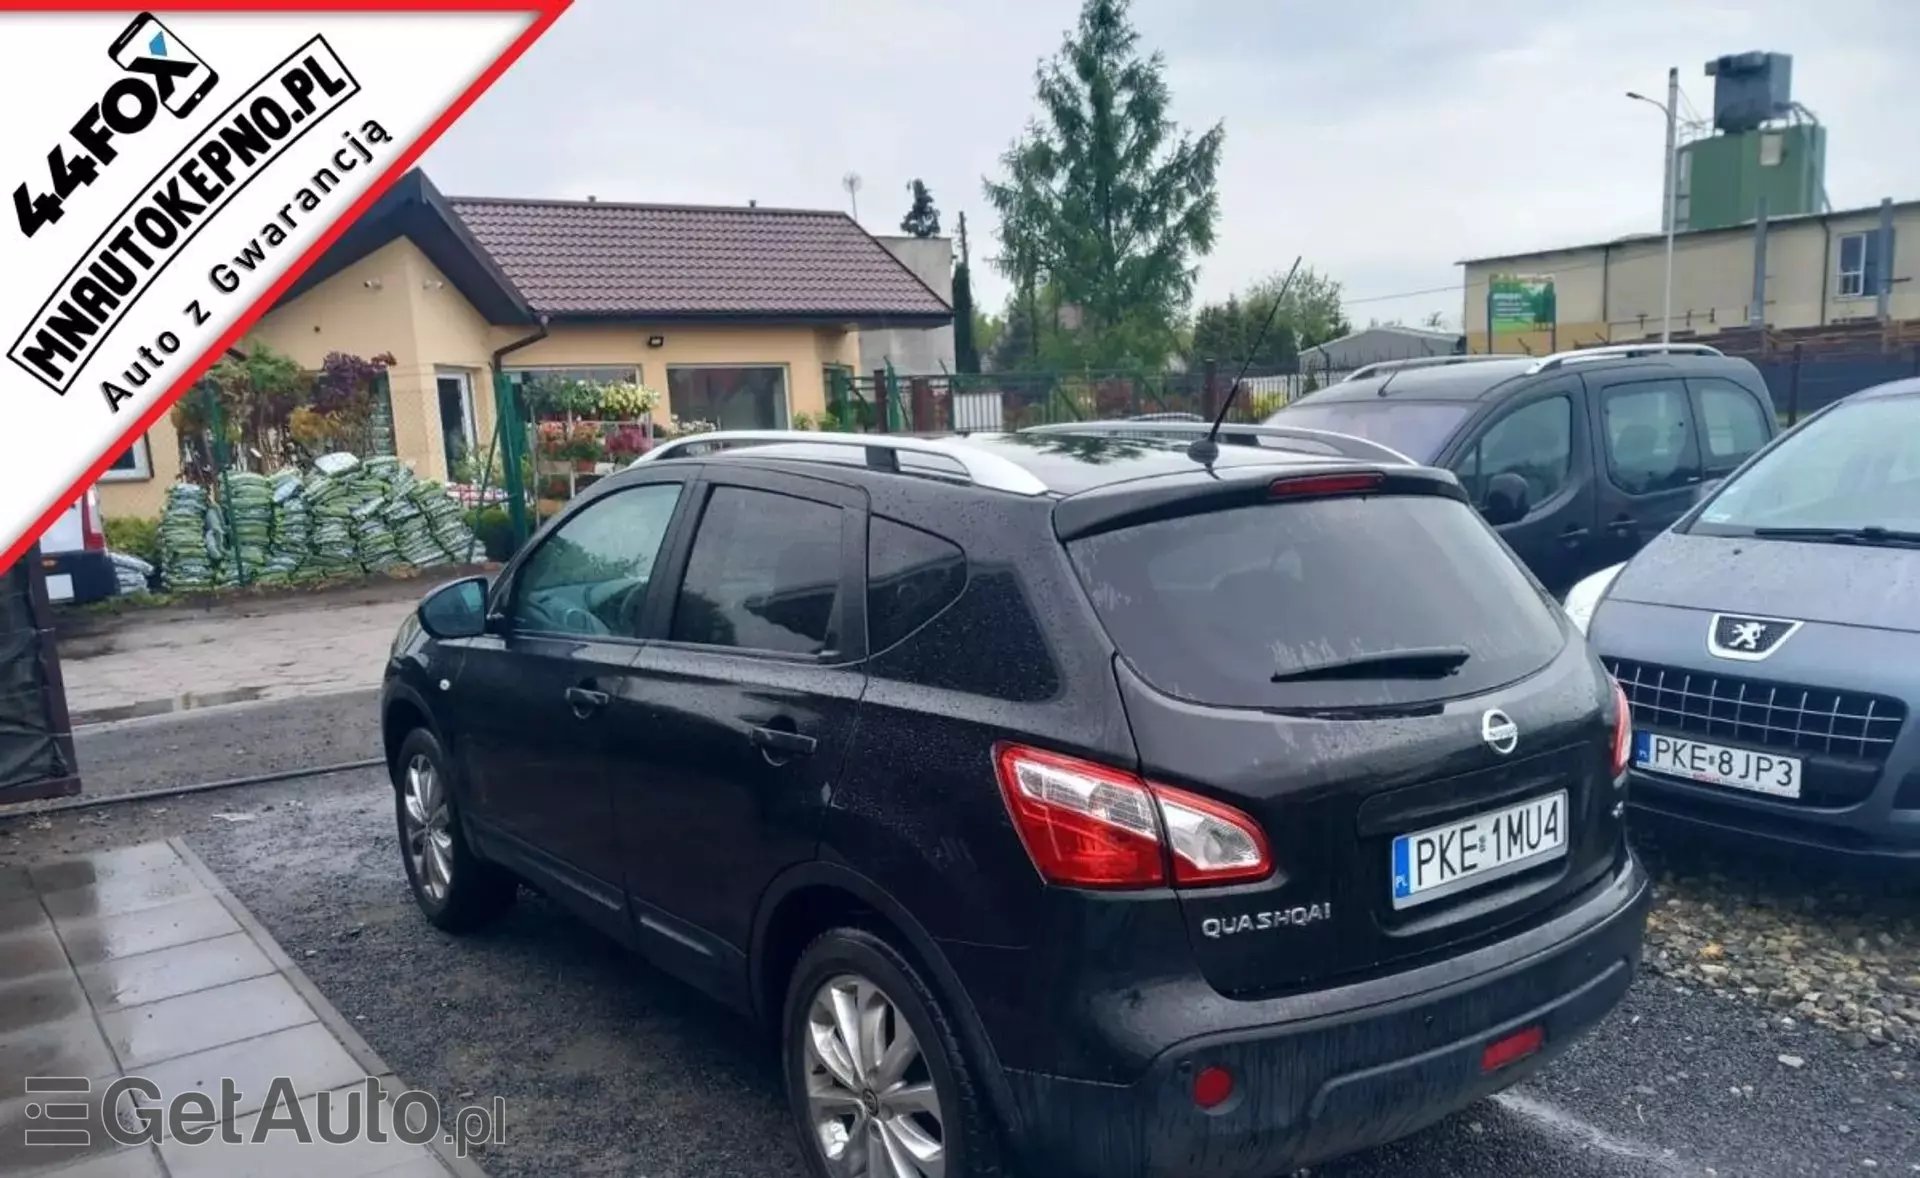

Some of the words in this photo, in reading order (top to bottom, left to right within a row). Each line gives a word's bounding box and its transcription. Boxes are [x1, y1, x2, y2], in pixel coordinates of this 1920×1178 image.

[1655, 737, 1707, 772] PKE
[1718, 750, 1793, 786] 8JP3
[1416, 824, 1478, 886] PKE
[1492, 800, 1559, 862] 1MU4
